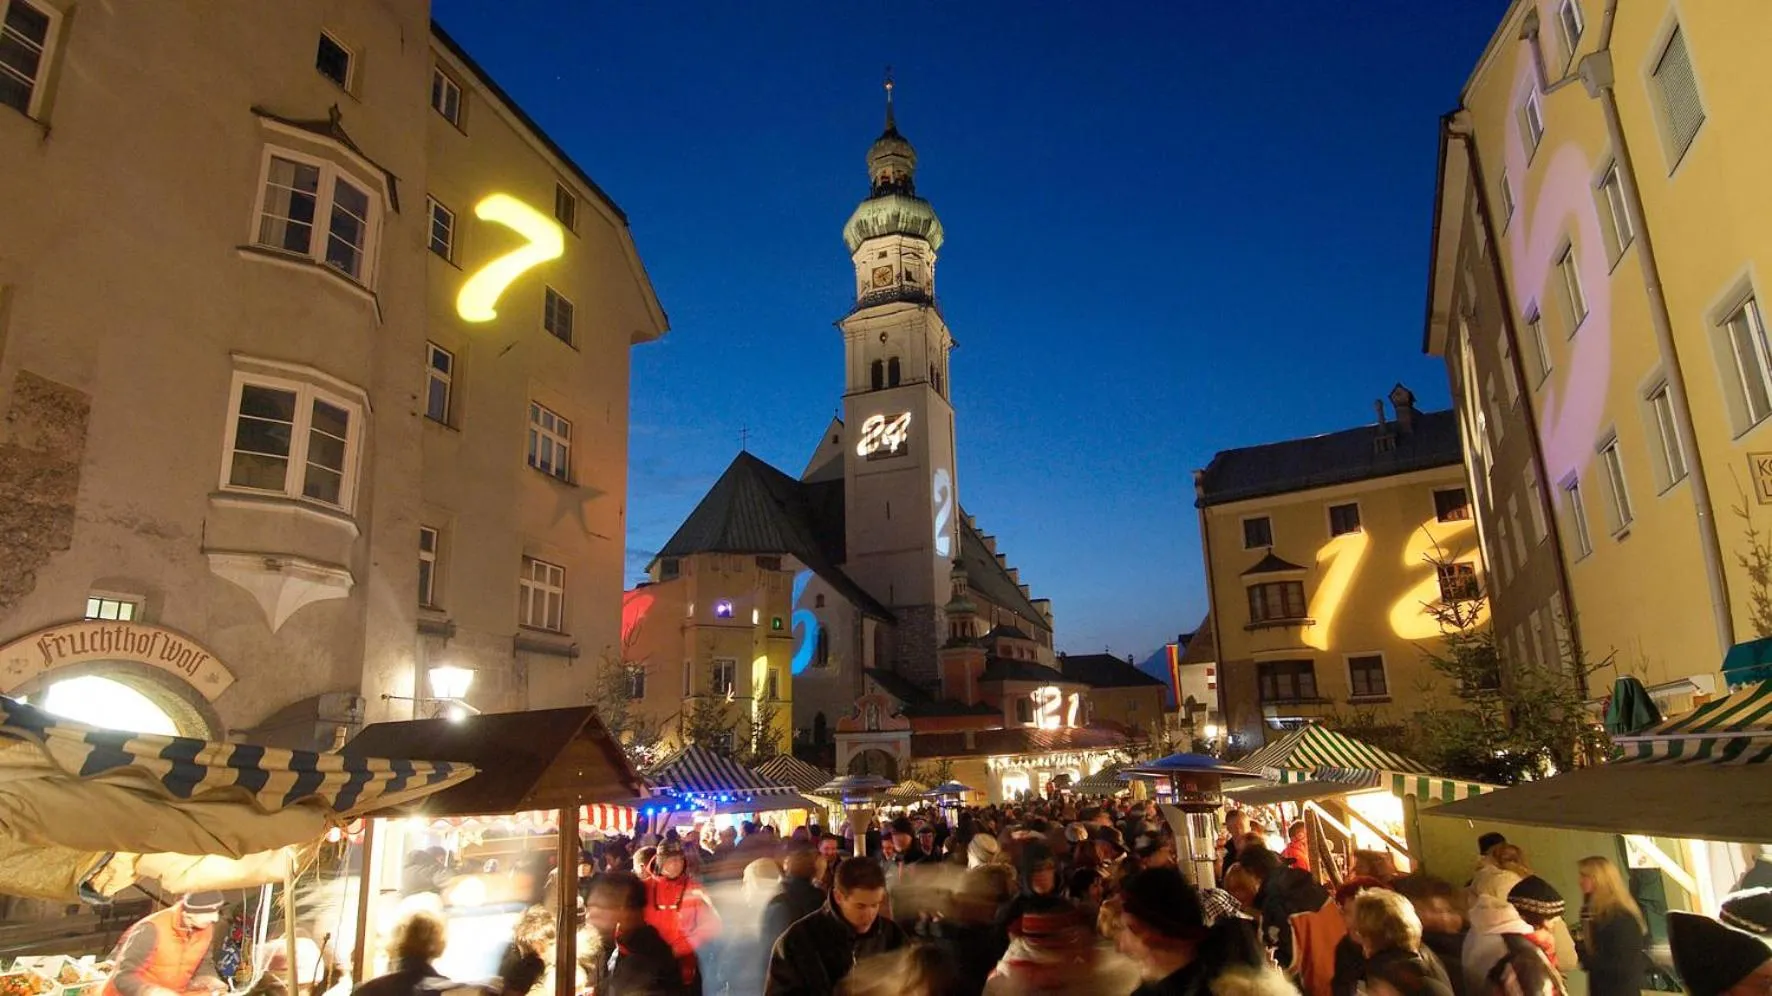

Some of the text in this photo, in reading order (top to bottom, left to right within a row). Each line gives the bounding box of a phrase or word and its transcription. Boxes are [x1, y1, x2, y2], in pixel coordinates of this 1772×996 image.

[456, 193, 564, 322] 7
[857, 412, 911, 456] 24
[933, 468, 951, 557] 2
[37, 625, 209, 677] Fruchthof Wolf
[1030, 686, 1080, 730] 21
